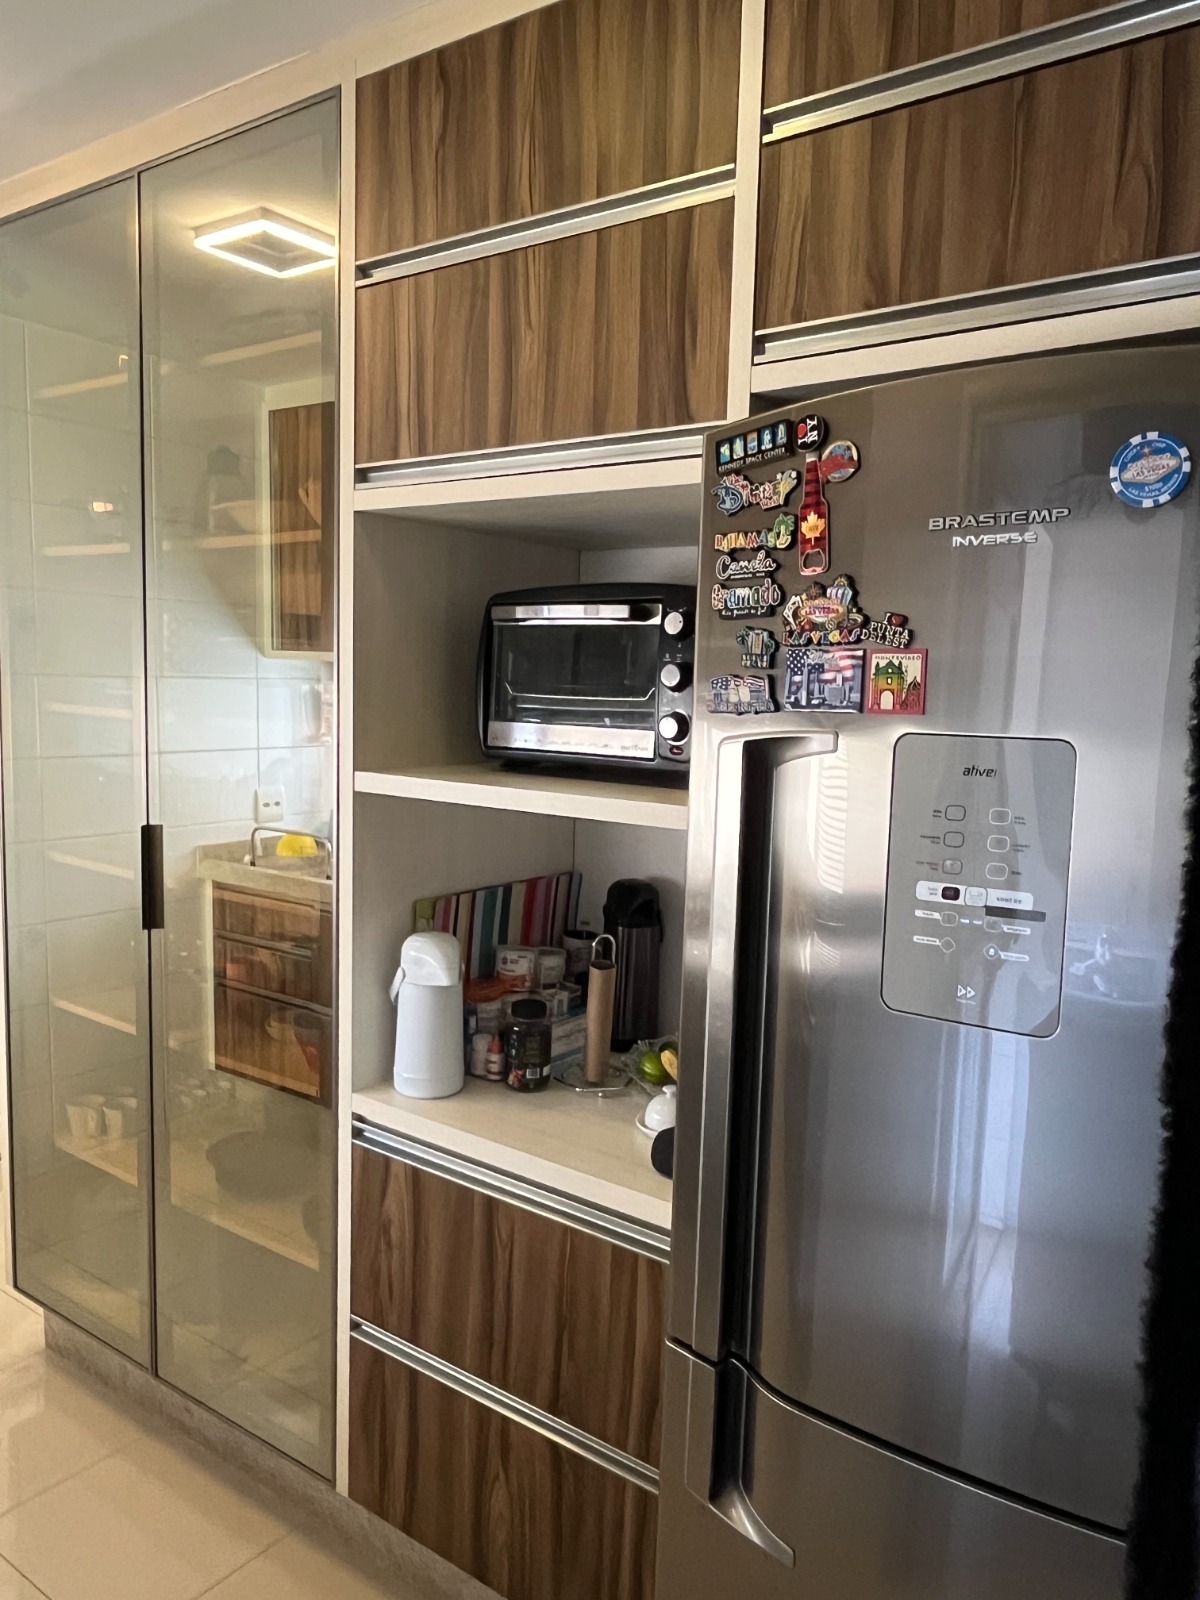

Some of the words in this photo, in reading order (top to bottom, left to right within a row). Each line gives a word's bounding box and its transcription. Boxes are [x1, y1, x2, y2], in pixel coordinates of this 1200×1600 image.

[806, 415, 819, 444] NY
[718, 459, 745, 472] KENNEDY
[745, 453, 762, 465] SPACE
[763, 447, 785, 459] CENTER
[928, 507, 1071, 531] BRASTEMP
[714, 528, 778, 553] BAHAMAS
[952, 531, 1039, 548] INVERSE
[711, 578, 781, 610] Gramado
[869, 621, 910, 640] PUNTA
[882, 612, 892, 625] I
[782, 630, 811, 645] LAS
[810, 627, 861, 645] VEGAS
